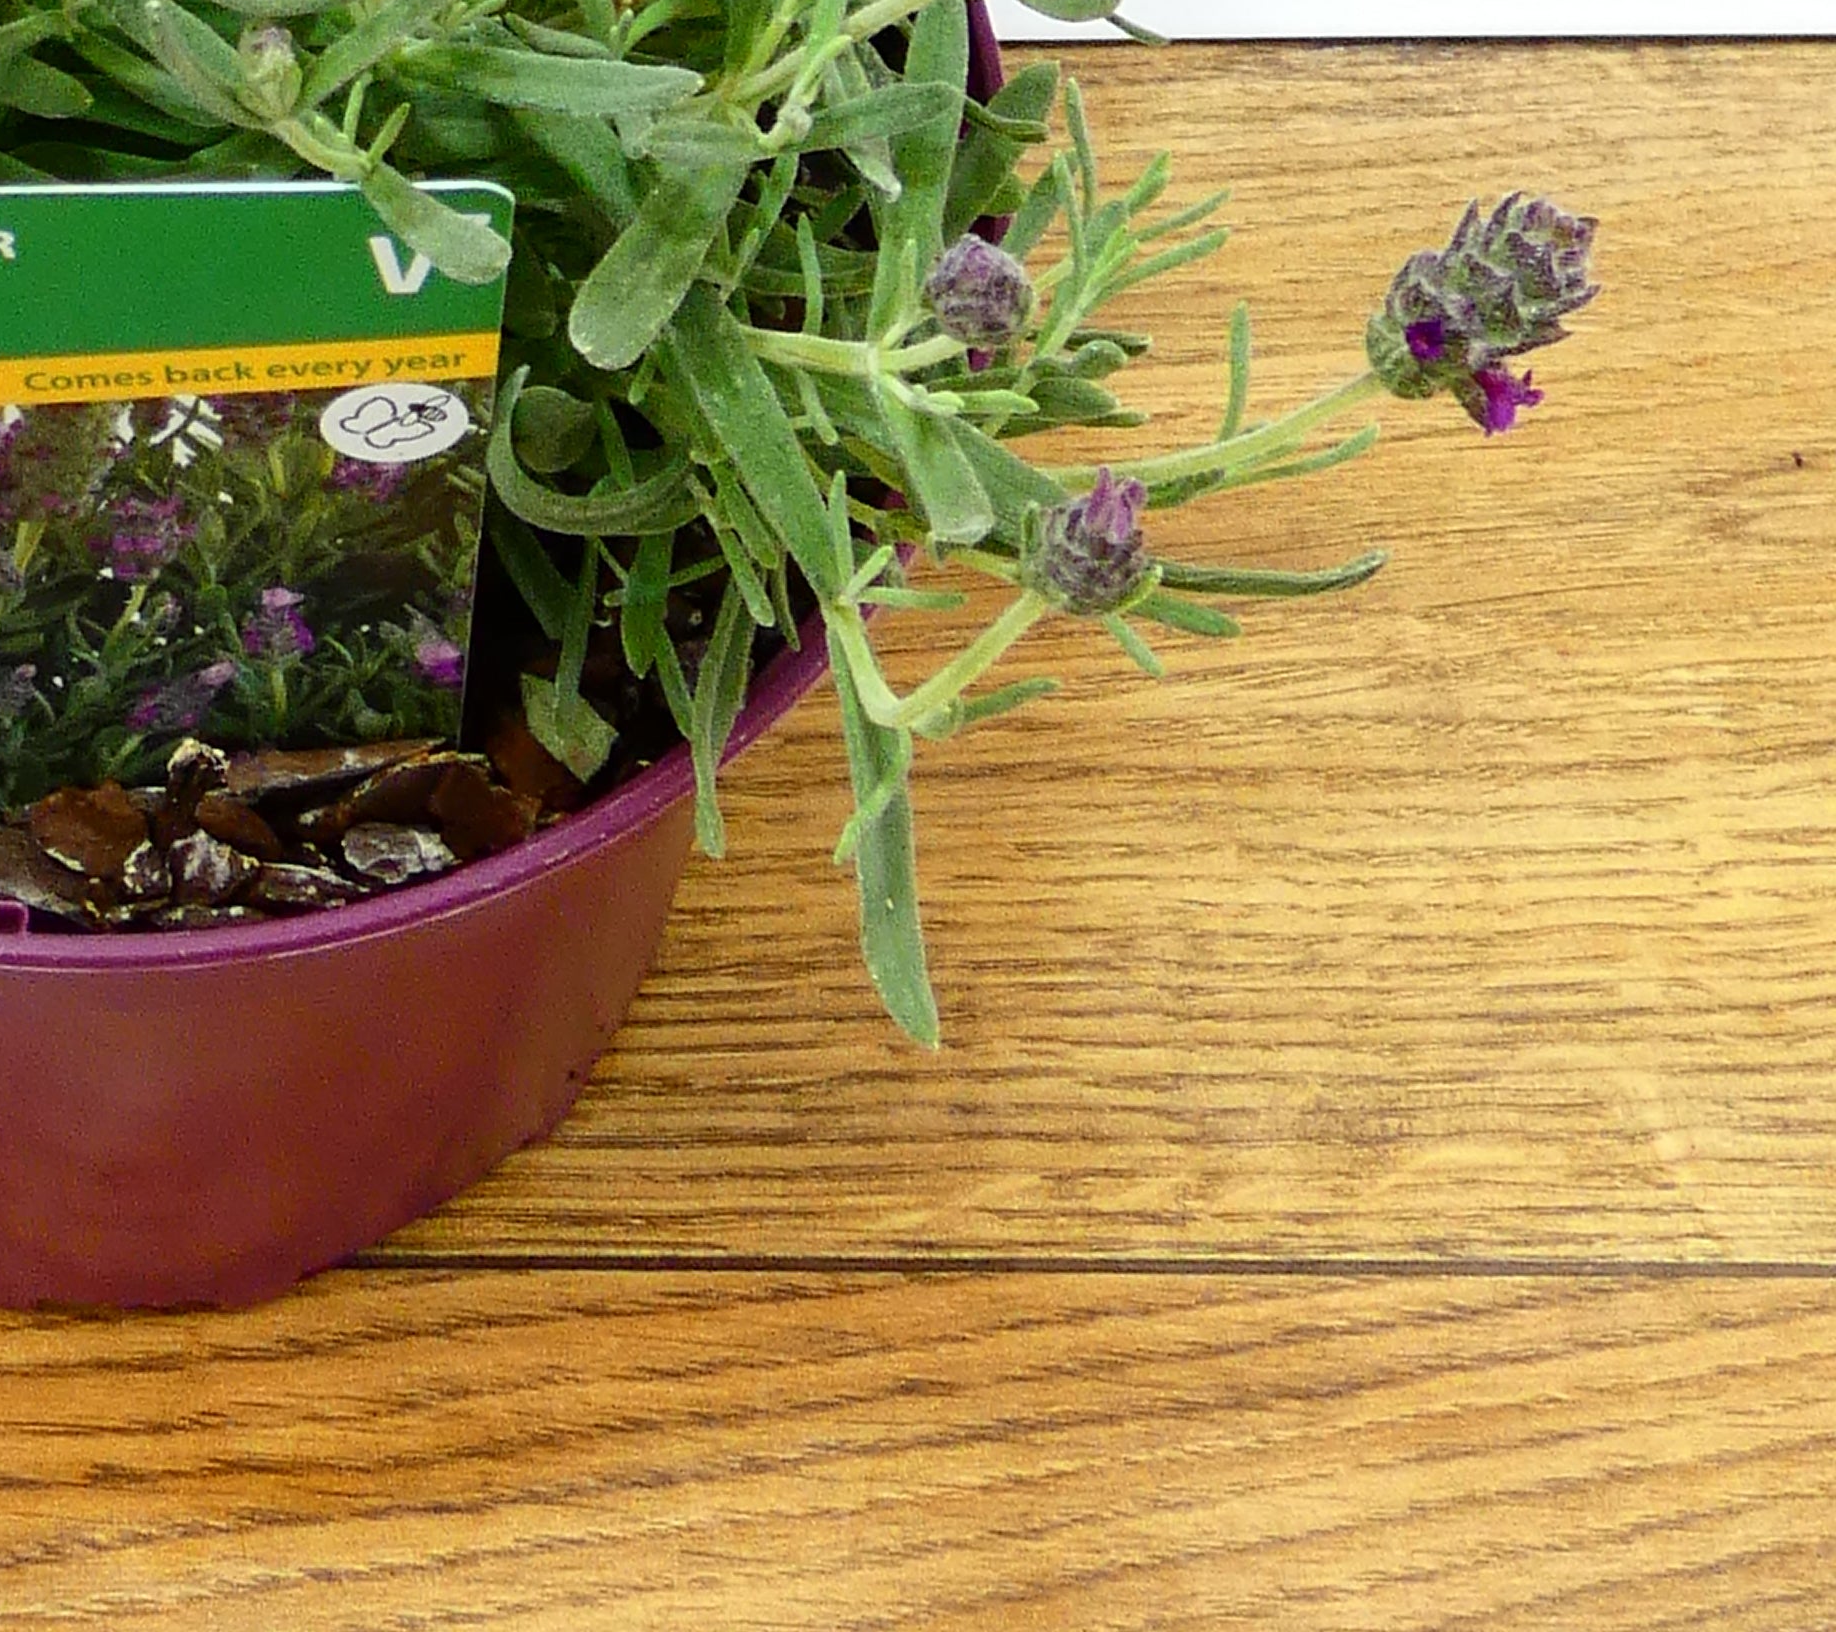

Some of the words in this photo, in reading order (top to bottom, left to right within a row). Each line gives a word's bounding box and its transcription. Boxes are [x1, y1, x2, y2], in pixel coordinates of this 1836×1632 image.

[23, 369, 153, 392] Comes
[165, 360, 256, 384] back
[265, 357, 372, 379] every
[382, 351, 468, 374] year
